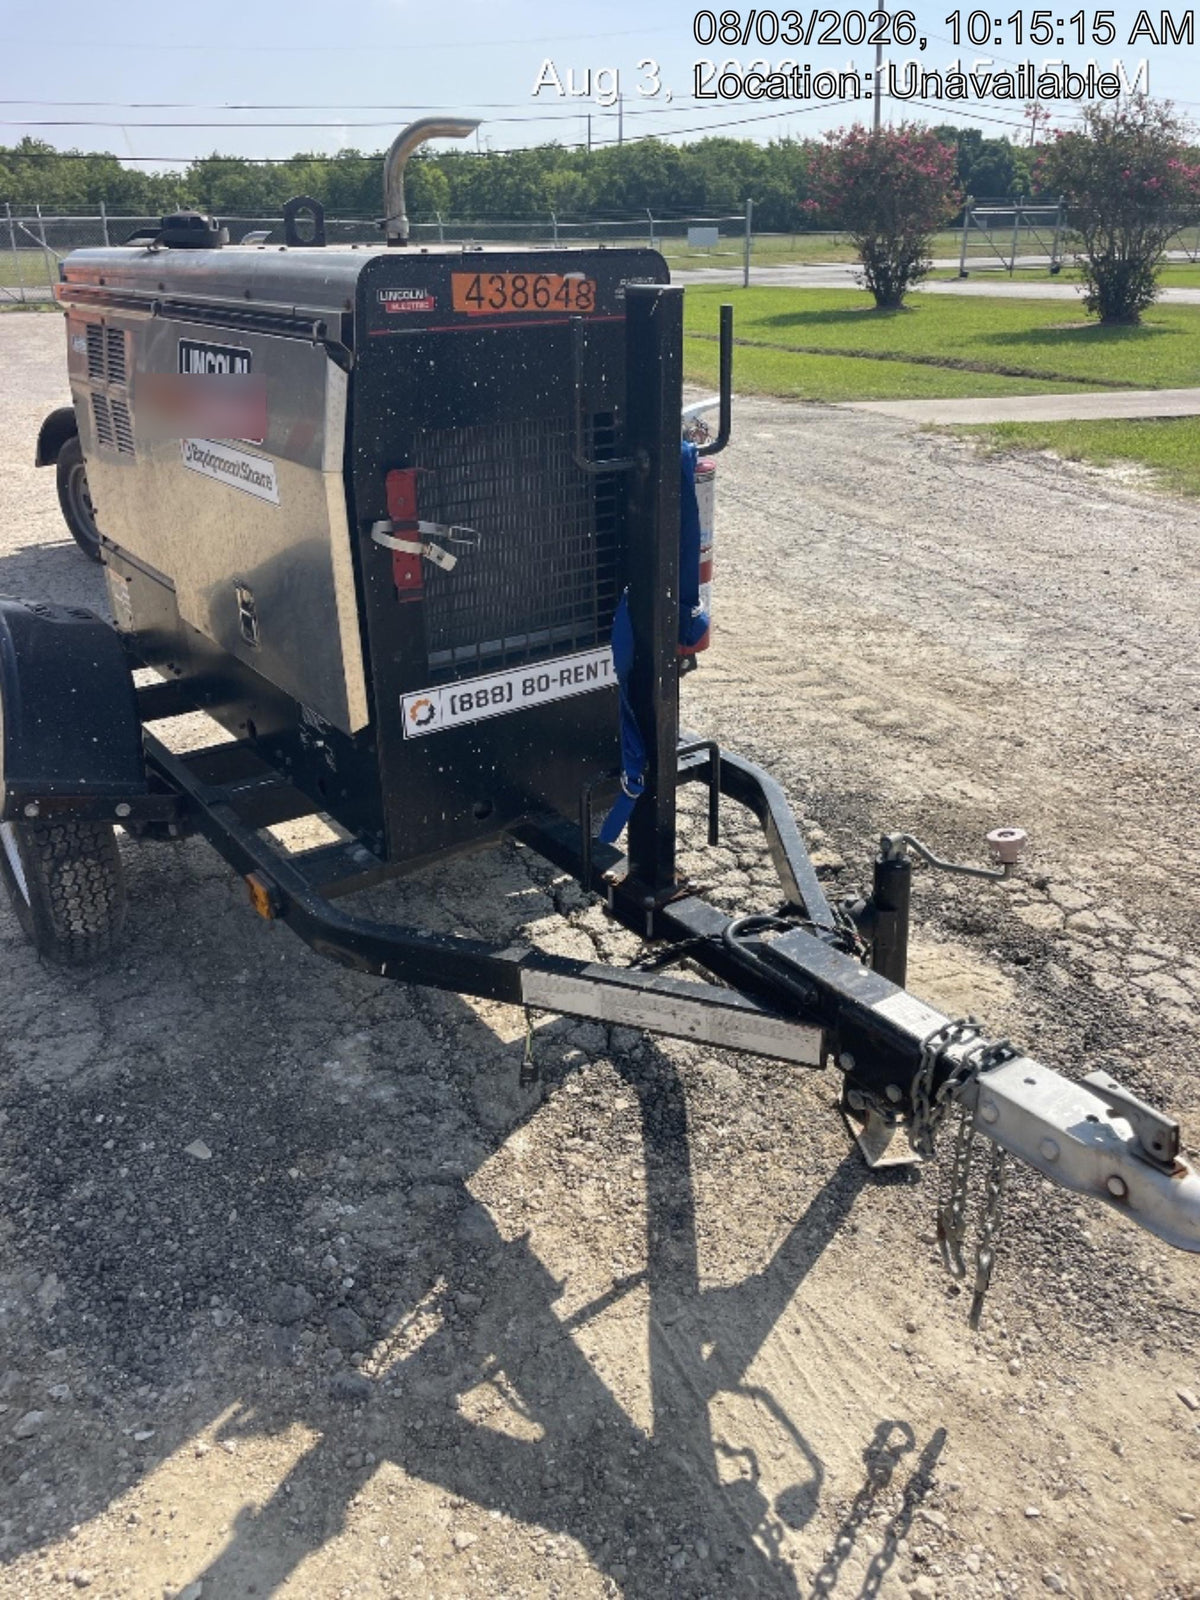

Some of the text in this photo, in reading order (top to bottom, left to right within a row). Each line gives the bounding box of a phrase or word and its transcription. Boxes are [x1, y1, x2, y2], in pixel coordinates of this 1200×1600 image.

[379, 290, 424, 301] LINCOLN
[465, 274, 593, 310] 438648
[522, 658, 612, 697] 80-RENT
